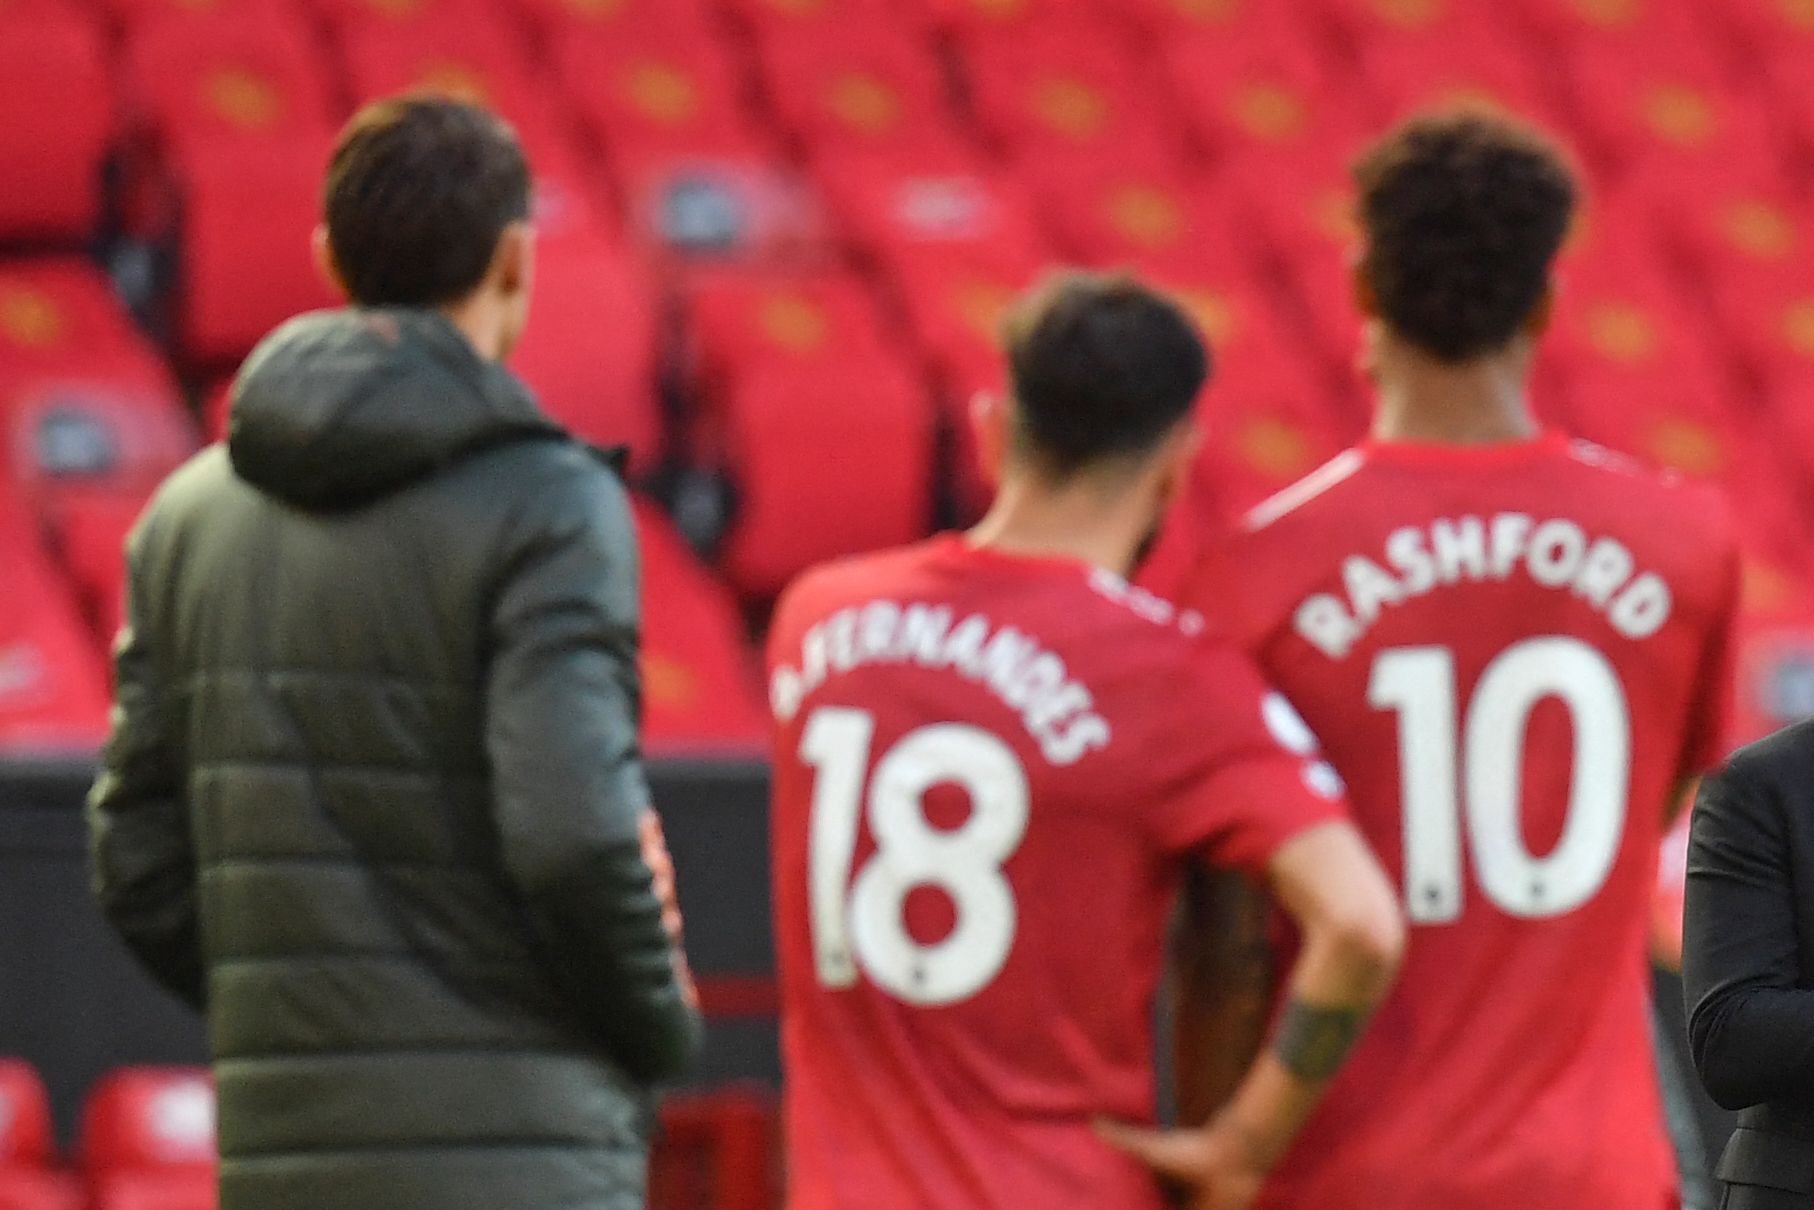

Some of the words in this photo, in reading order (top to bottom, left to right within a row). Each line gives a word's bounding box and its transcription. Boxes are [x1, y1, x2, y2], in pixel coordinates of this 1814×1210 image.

[1294, 512, 1671, 661] RASHFORD
[799, 706, 1031, 1006] 18
[1368, 636, 1630, 924] 10
